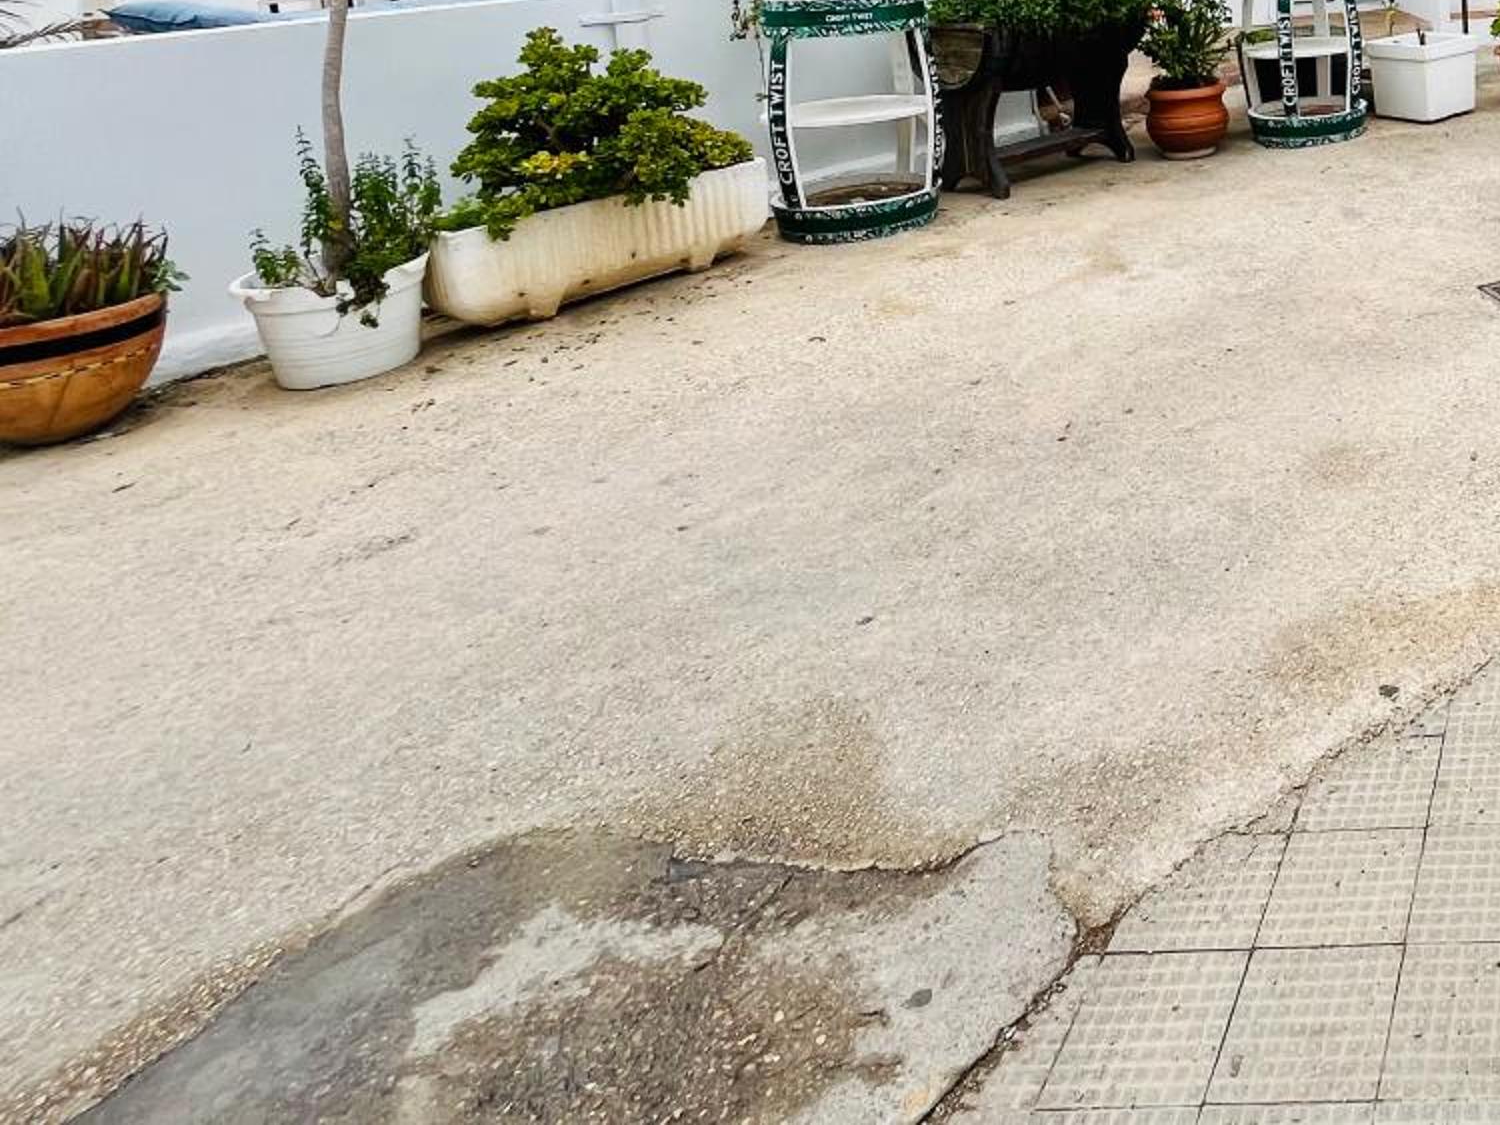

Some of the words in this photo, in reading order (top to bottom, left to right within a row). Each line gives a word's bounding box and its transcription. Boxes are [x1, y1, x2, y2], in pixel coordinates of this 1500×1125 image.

[1279, 12, 1292, 57] TWIST
[769, 61, 785, 116] TWIST
[1282, 61, 1297, 106] CROFT
[772, 127, 794, 185] CROFT
